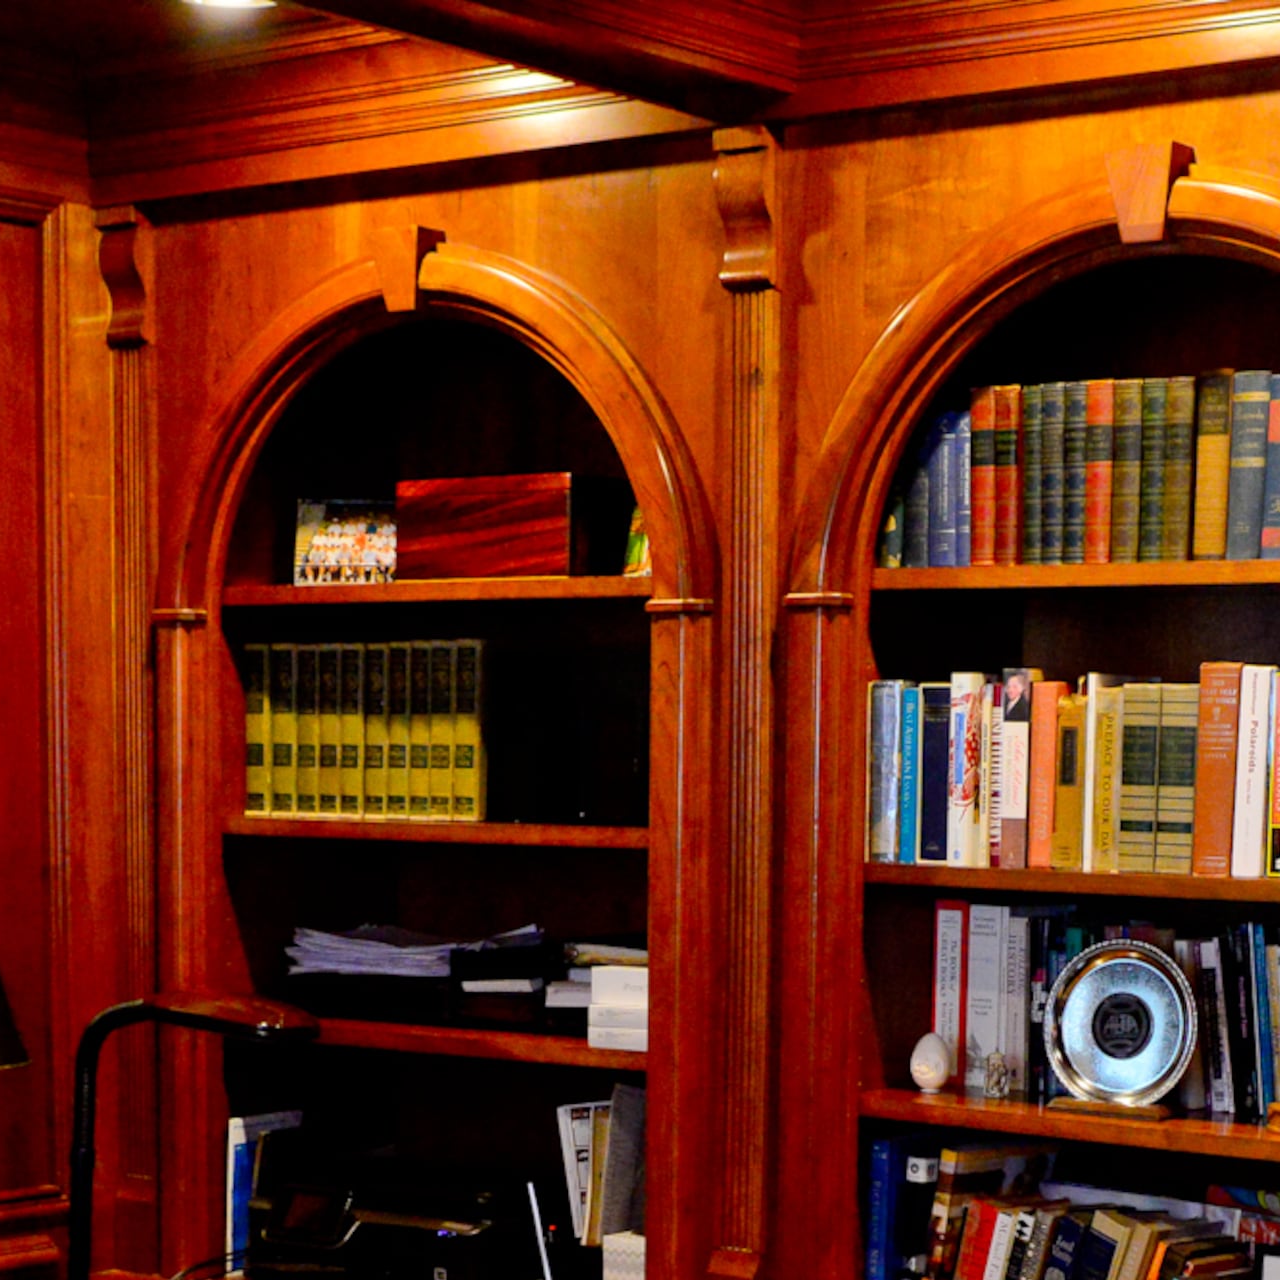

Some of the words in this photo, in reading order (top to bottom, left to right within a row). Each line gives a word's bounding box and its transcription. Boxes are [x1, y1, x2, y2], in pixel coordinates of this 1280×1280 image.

[1104, 716, 1113, 767] PREFACE
[1248, 720, 1259, 774] Polaroids
[1102, 775, 1111, 792] TO
[1102, 797, 1111, 825] OUR
[1101, 832, 1110, 856] DAY
[940, 931, 949, 962] GREAT
[949, 956, 957, 982] BOOK
[1007, 934, 1018, 995] HISTORY
[939, 965, 948, 997] BOOKS
[870, 1249, 879, 1275] NEW
